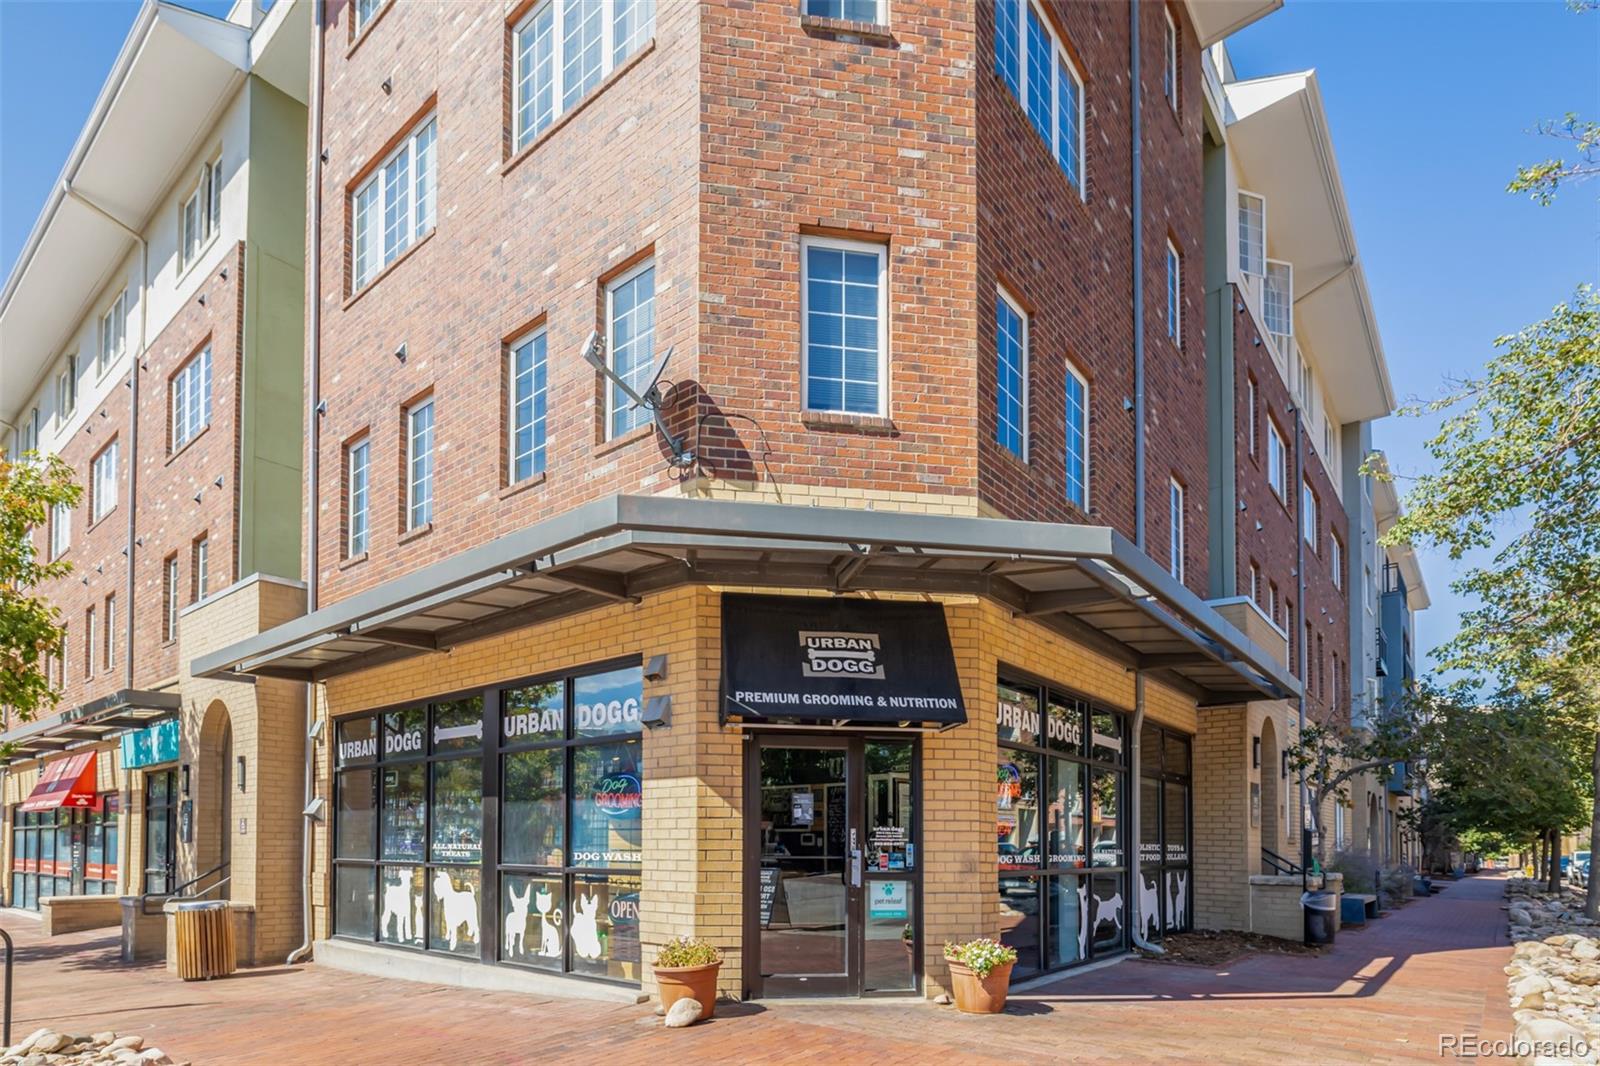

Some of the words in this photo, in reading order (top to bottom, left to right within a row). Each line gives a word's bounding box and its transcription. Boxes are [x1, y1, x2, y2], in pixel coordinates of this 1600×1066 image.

[808, 637, 872, 650] URBAN
[812, 658, 875, 673] DOGG
[735, 691, 800, 705] PREMIUM
[802, 693, 873, 707] GROOMING
[877, 696, 888, 707] &
[890, 697, 958, 709] NUTRITION
[504, 709, 564, 737] URBAN
[577, 697, 638, 727] DOGG
[1049, 716, 1082, 745] DOGG
[339, 737, 377, 760] URBAN
[385, 730, 422, 754] DOGG
[574, 852, 600, 861] DOG
[602, 852, 642, 861] WASH
[998, 855, 1014, 864] OG
[1014, 854, 1041, 864] WASH
[611, 900, 640, 919] OPEN
